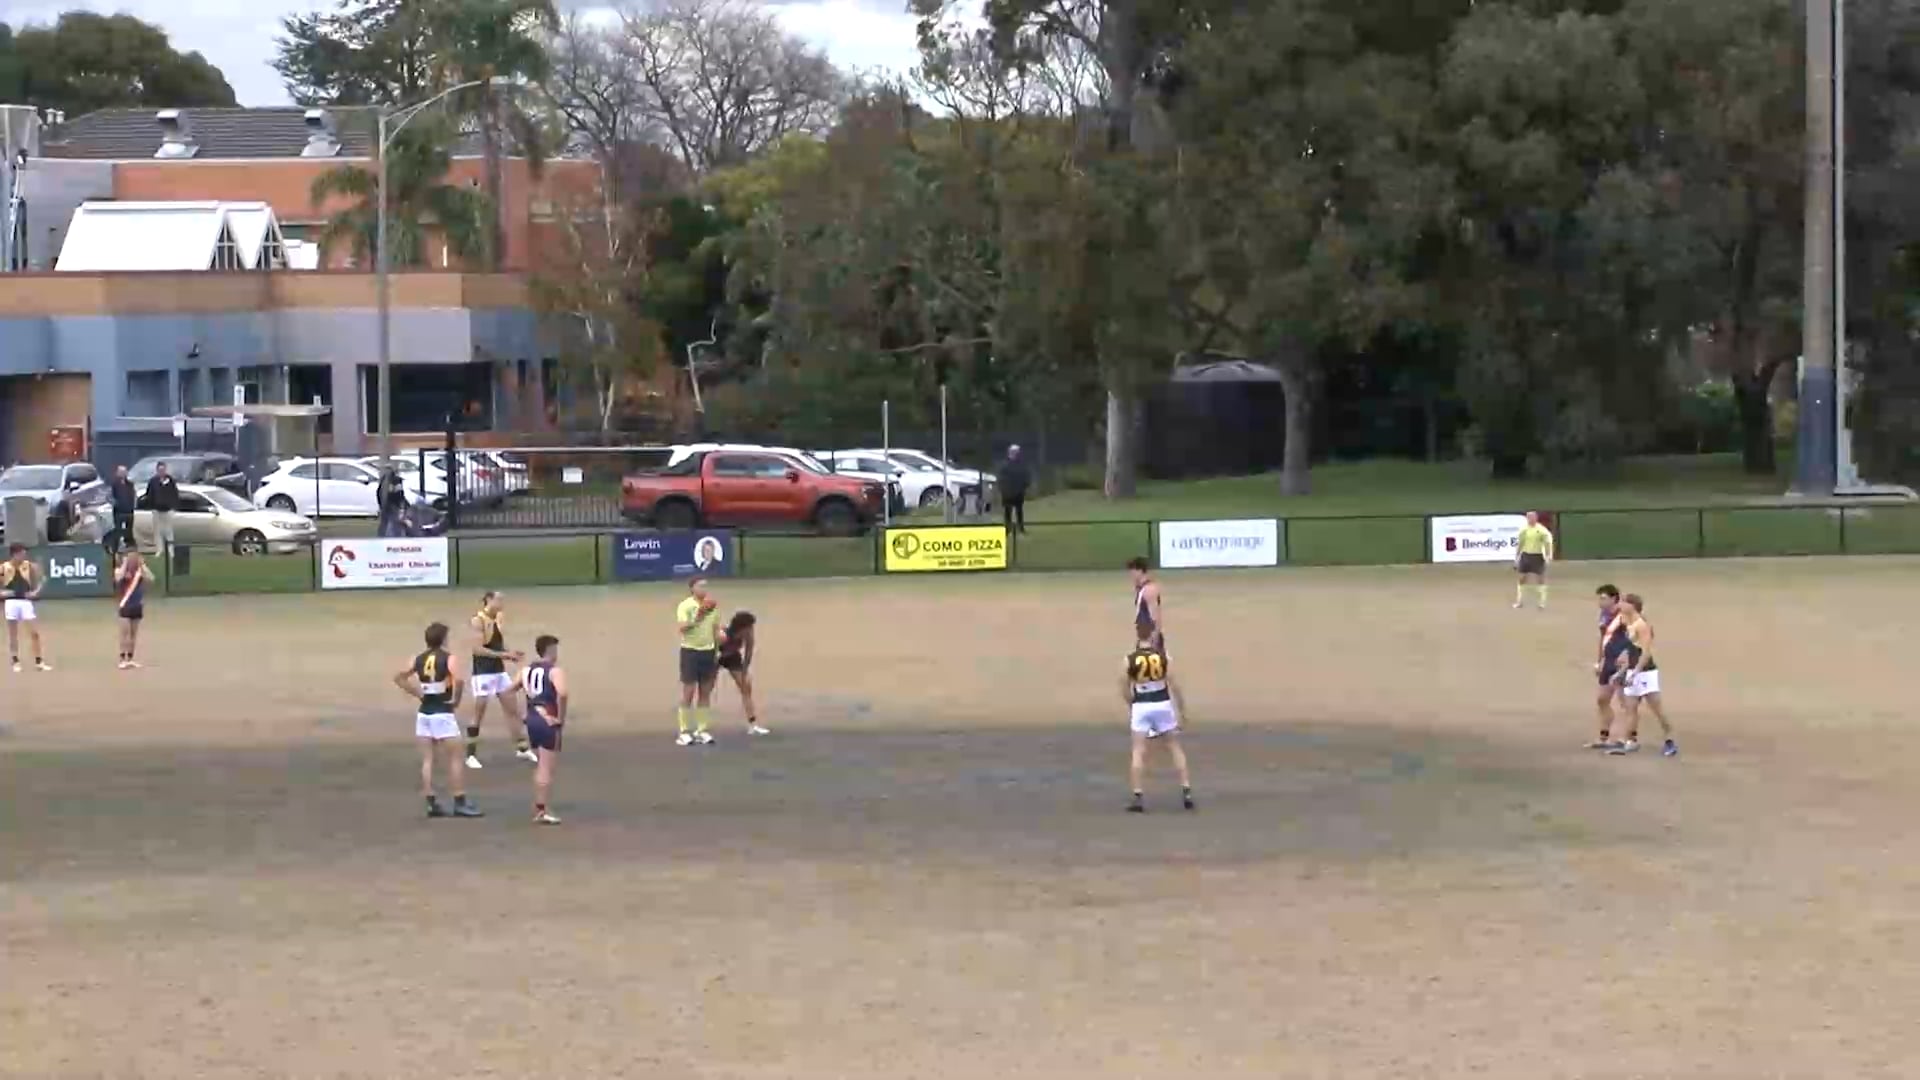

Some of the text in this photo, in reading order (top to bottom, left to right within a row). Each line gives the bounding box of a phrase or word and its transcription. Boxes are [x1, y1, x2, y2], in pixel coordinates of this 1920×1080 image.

[624, 538, 661, 550] Lewin
[922, 539, 1003, 553] COMO PIZZA
[1462, 538, 1508, 550] Bendigo
[49, 557, 97, 578] belle
[423, 654, 437, 682] 4
[1135, 653, 1163, 682] 28
